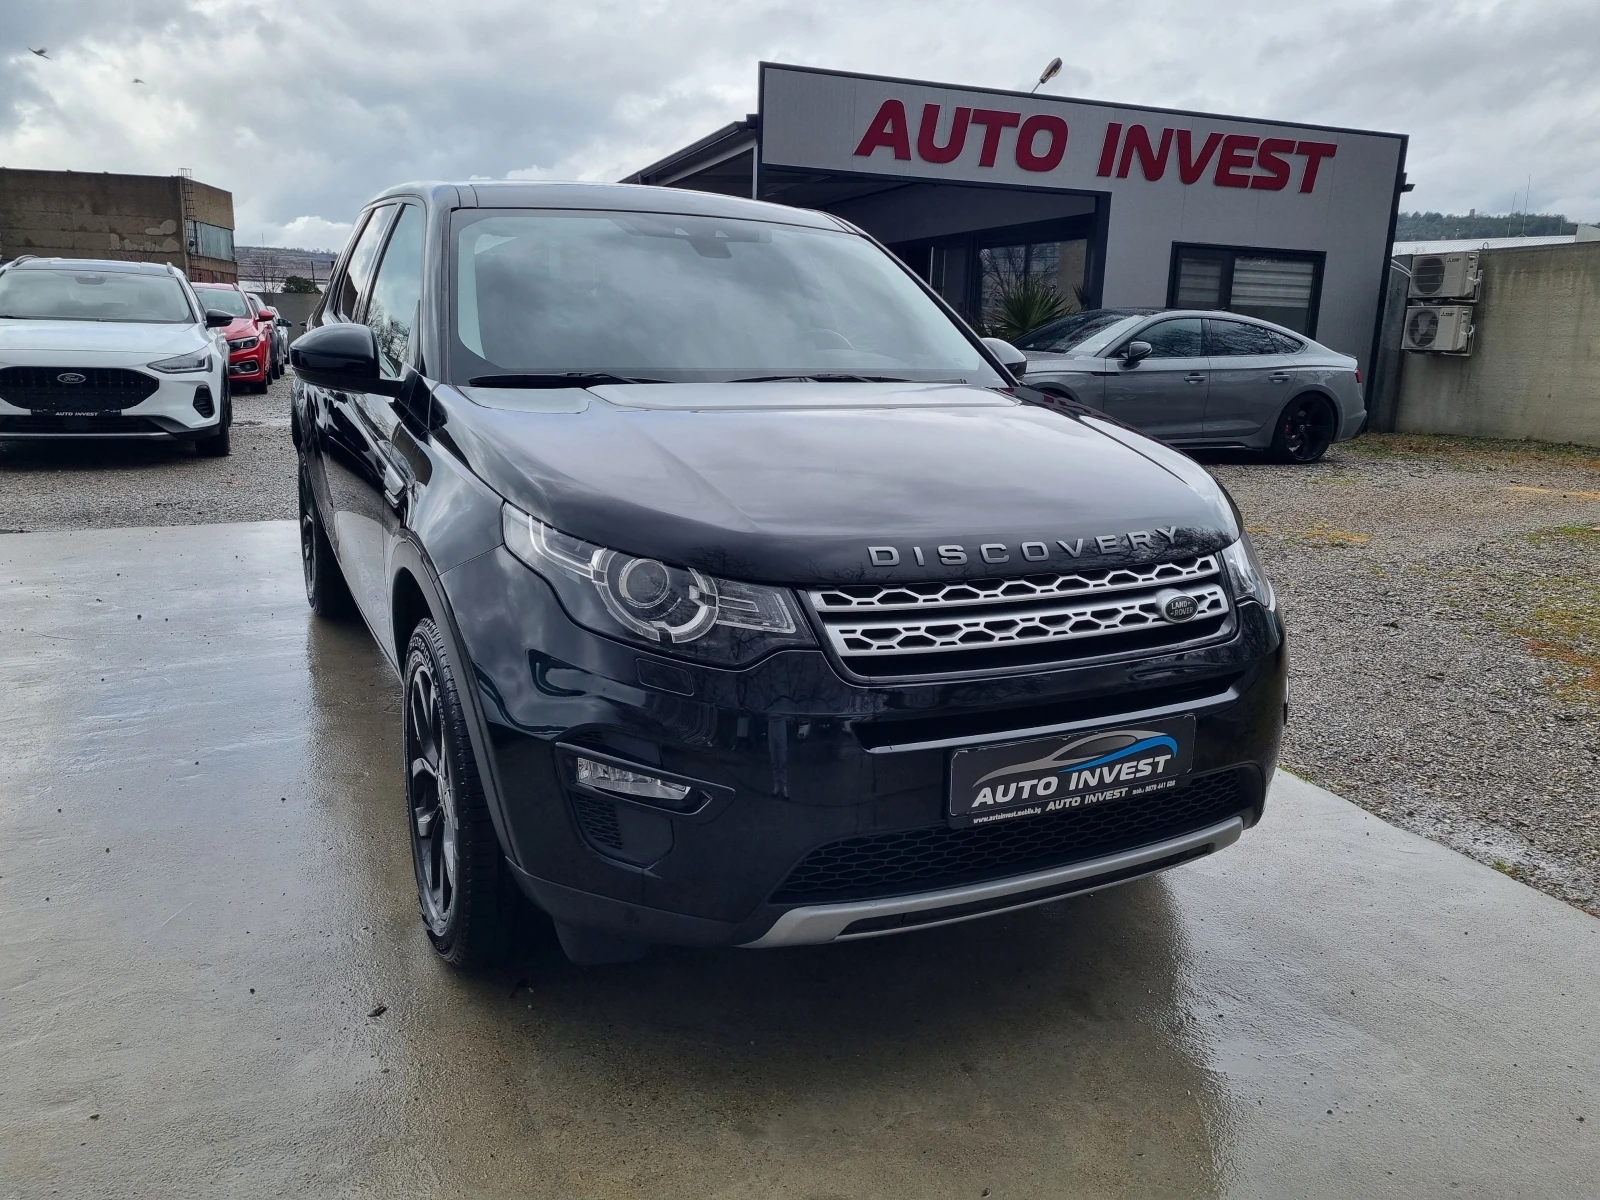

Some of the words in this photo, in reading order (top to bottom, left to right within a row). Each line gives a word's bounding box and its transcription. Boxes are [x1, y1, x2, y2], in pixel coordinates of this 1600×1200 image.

[854, 99, 1069, 172] AUTO
[1096, 122, 1338, 194] INVEST
[867, 526, 1177, 567] DISCOVERY
[1171, 600, 1188, 610] LAND
[1173, 606, 1193, 617] ROVER
[971, 776, 1059, 808] AUTO
[1068, 754, 1172, 791] INVEST
[1046, 796, 1081, 812] AUTO
[1084, 787, 1129, 805] INVEST
